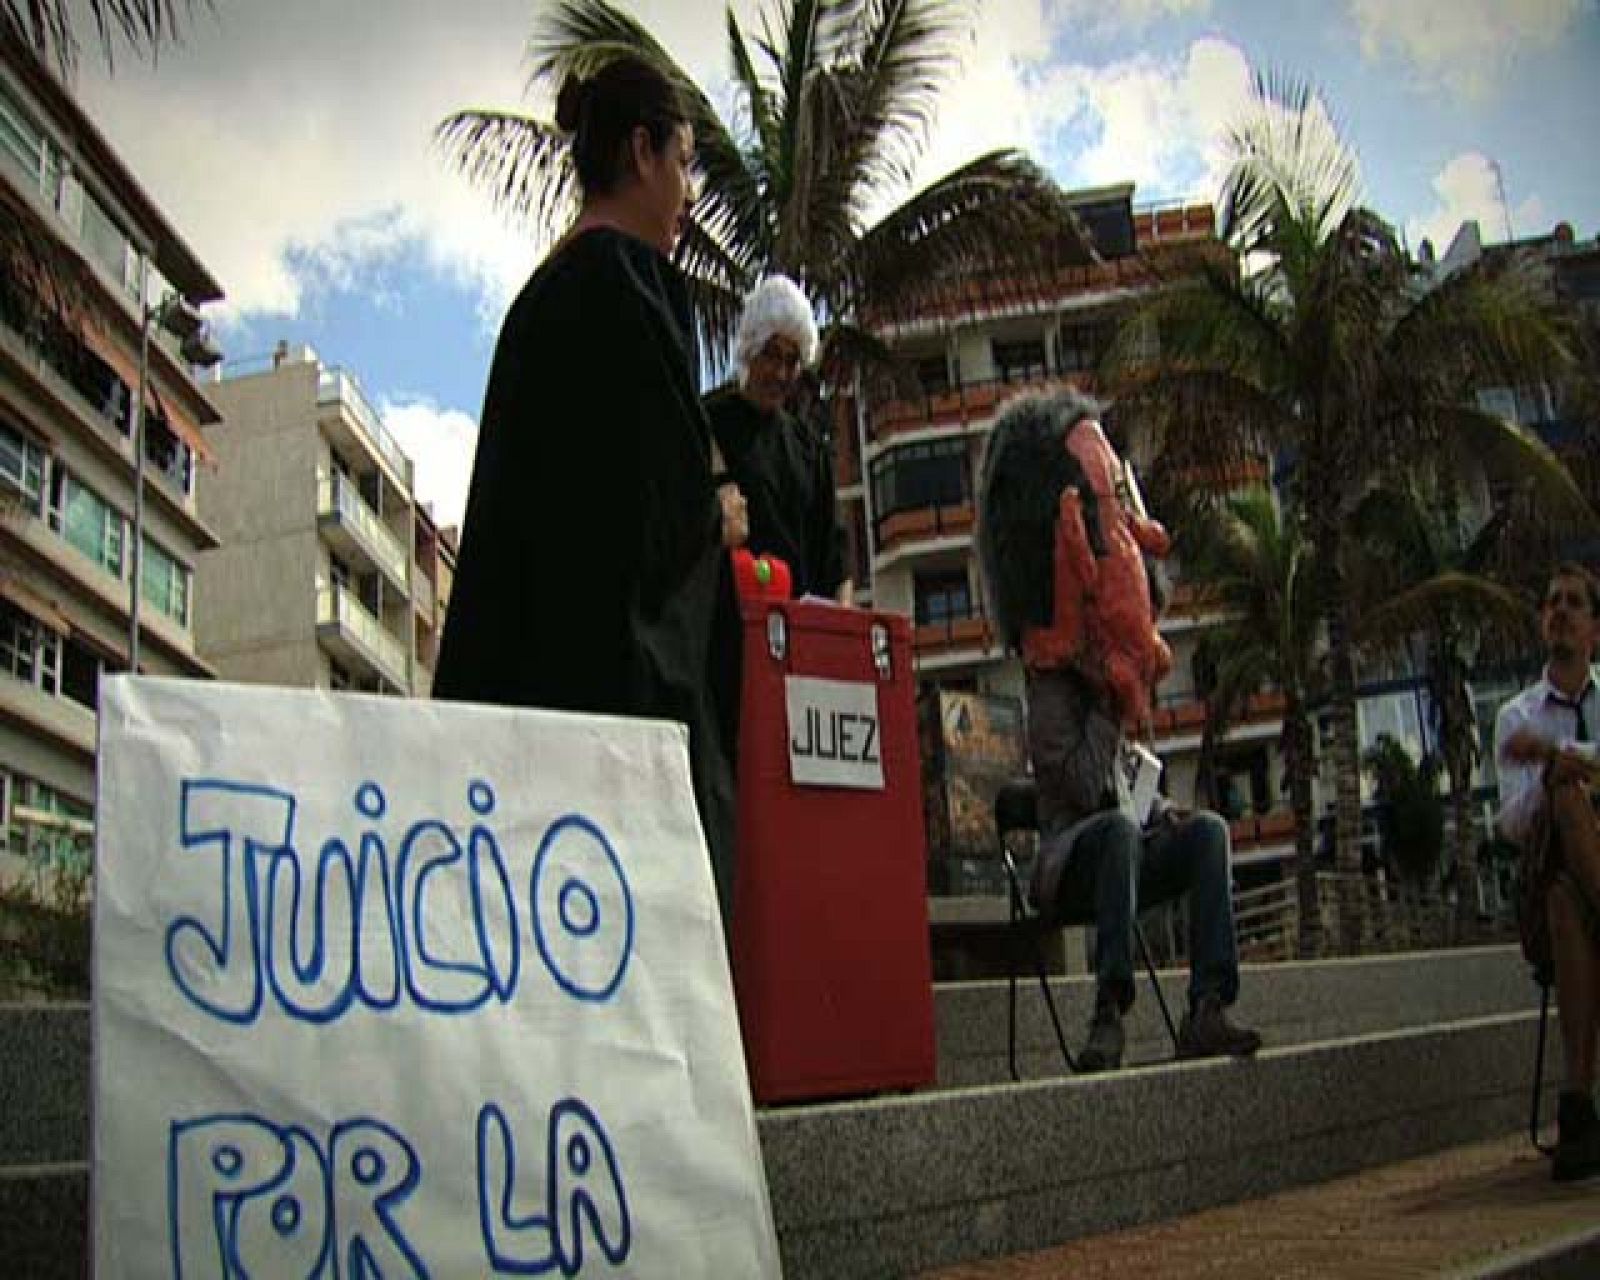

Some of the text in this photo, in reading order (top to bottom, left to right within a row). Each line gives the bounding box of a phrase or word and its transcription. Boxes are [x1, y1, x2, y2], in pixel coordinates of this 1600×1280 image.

[792, 707, 878, 764] JUEZ
[170, 1098, 631, 1280] POR LA
